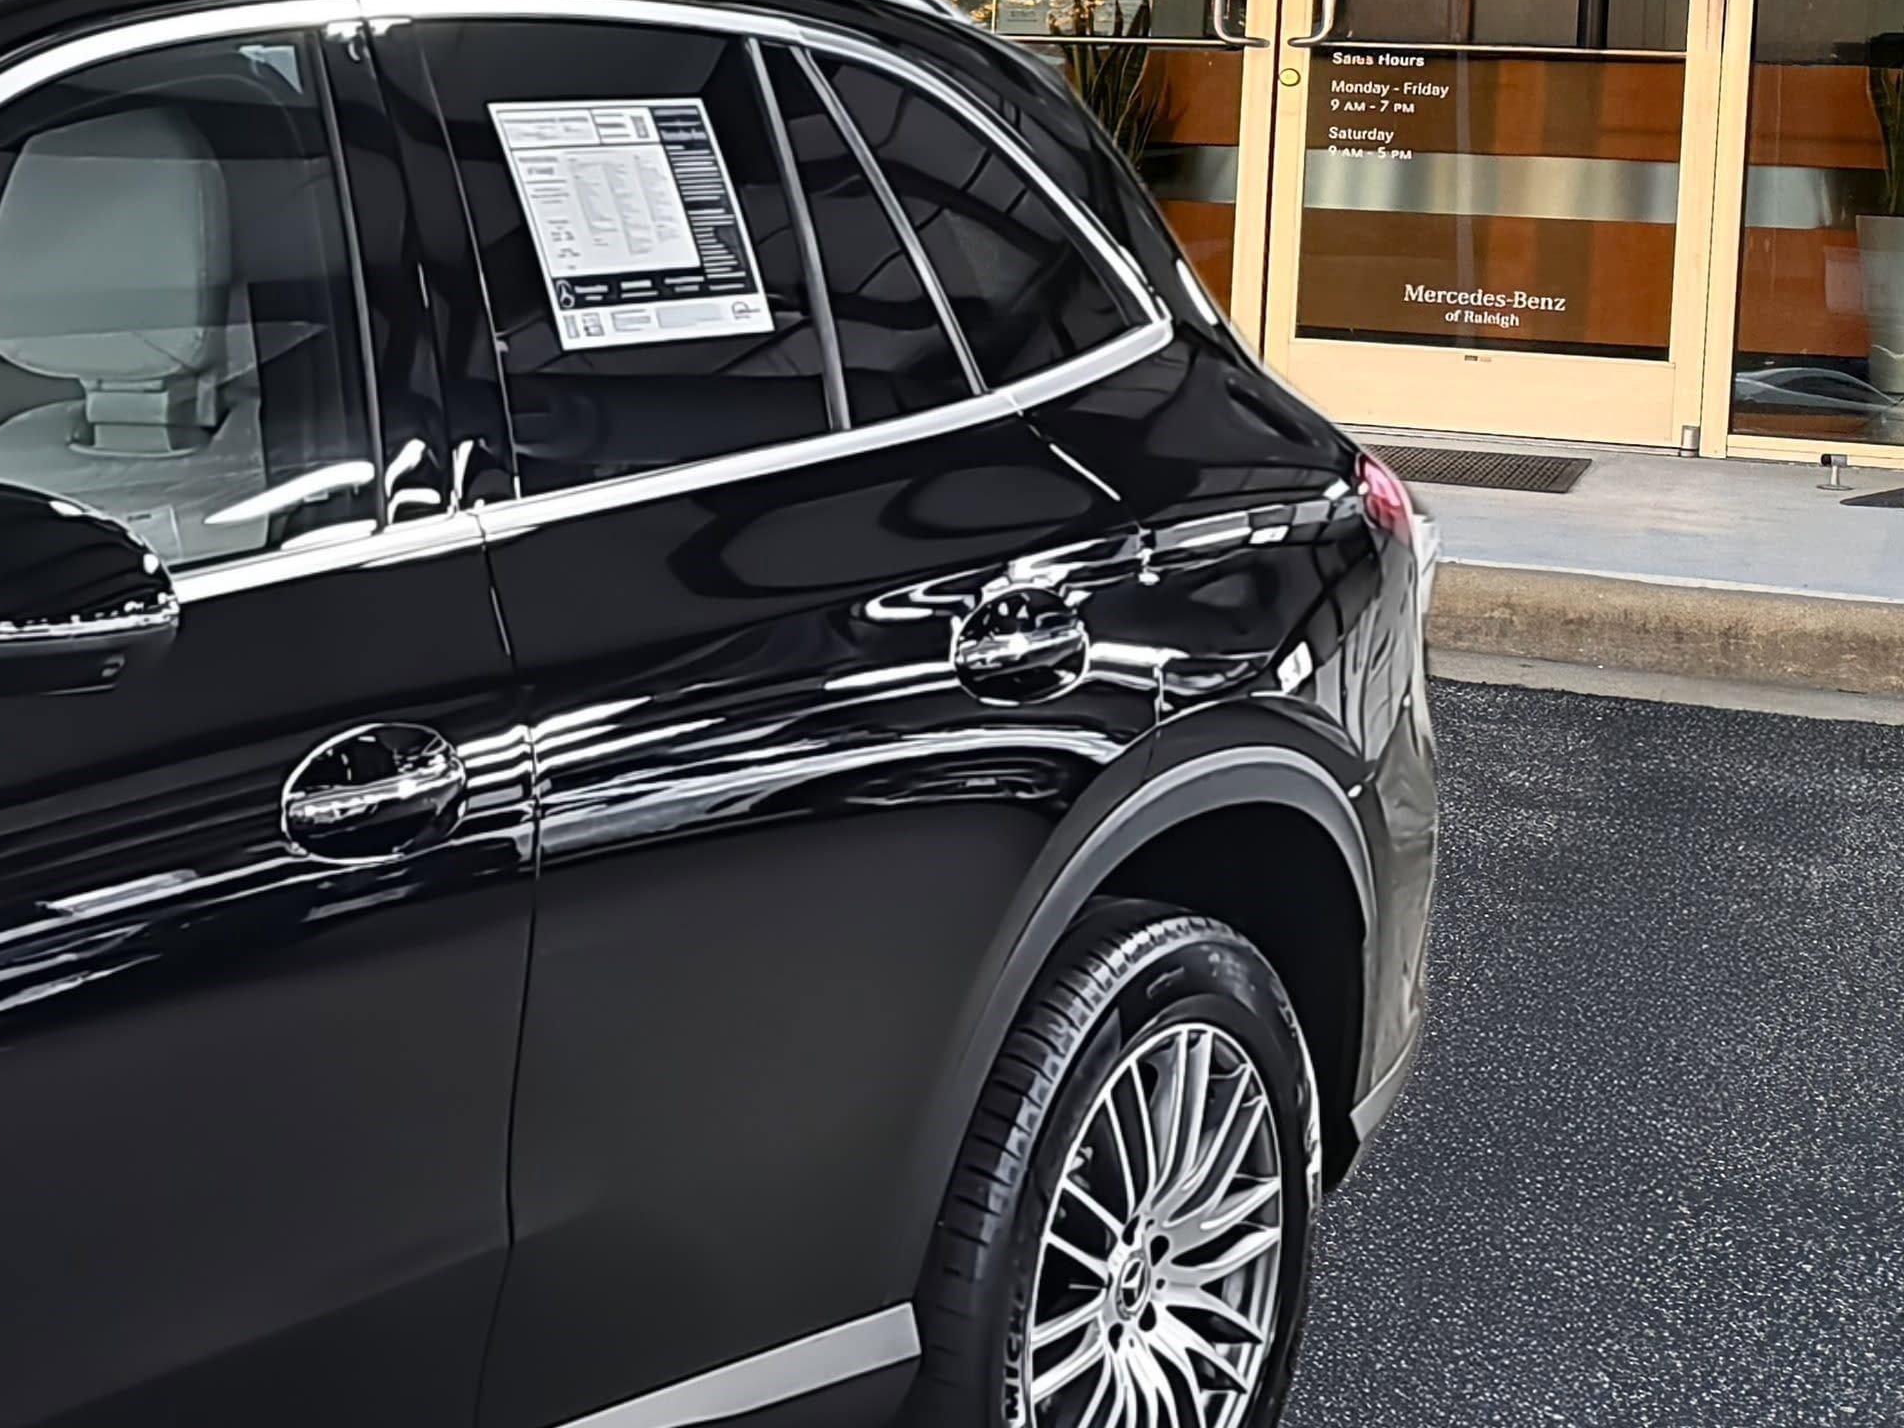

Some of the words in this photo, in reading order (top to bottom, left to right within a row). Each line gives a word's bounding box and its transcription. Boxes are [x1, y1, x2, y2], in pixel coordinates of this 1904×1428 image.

[1378, 53, 1425, 67] Hours
[1331, 80, 1390, 97] Monday
[1403, 82, 1449, 99] Friday
[1330, 99, 1340, 111] 9
[1344, 102, 1366, 112] AM
[1379, 100, 1389, 112] 7
[1393, 103, 1415, 113] PM
[1328, 126, 1394, 144] Saturday
[1328, 145, 1337, 157] 9
[1342, 148, 1364, 158] AM
[1377, 147, 1386, 159] 5
[1391, 149, 1412, 159] PM
[1403, 284, 1566, 312] Mercedes-Benz
[1445, 309, 1462, 322] of
[1464, 310, 1520, 329] Raleigh
